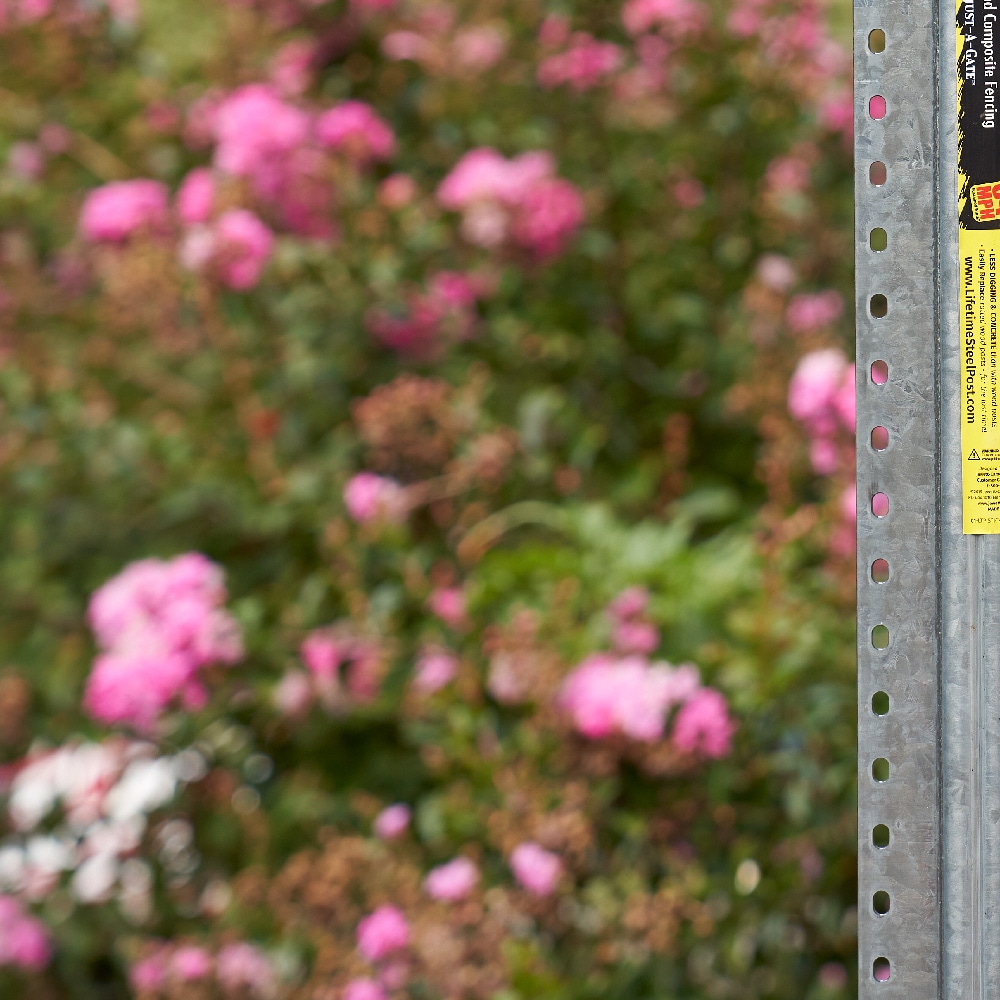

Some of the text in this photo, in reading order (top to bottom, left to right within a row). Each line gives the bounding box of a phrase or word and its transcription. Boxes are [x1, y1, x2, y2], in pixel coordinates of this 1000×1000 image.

[981, 13, 997, 77] Composite
[981, 81, 998, 128] Fencing
[976, 185, 995, 220] MPH
[965, 256, 976, 424] www.LifetimeSteelPost.com
